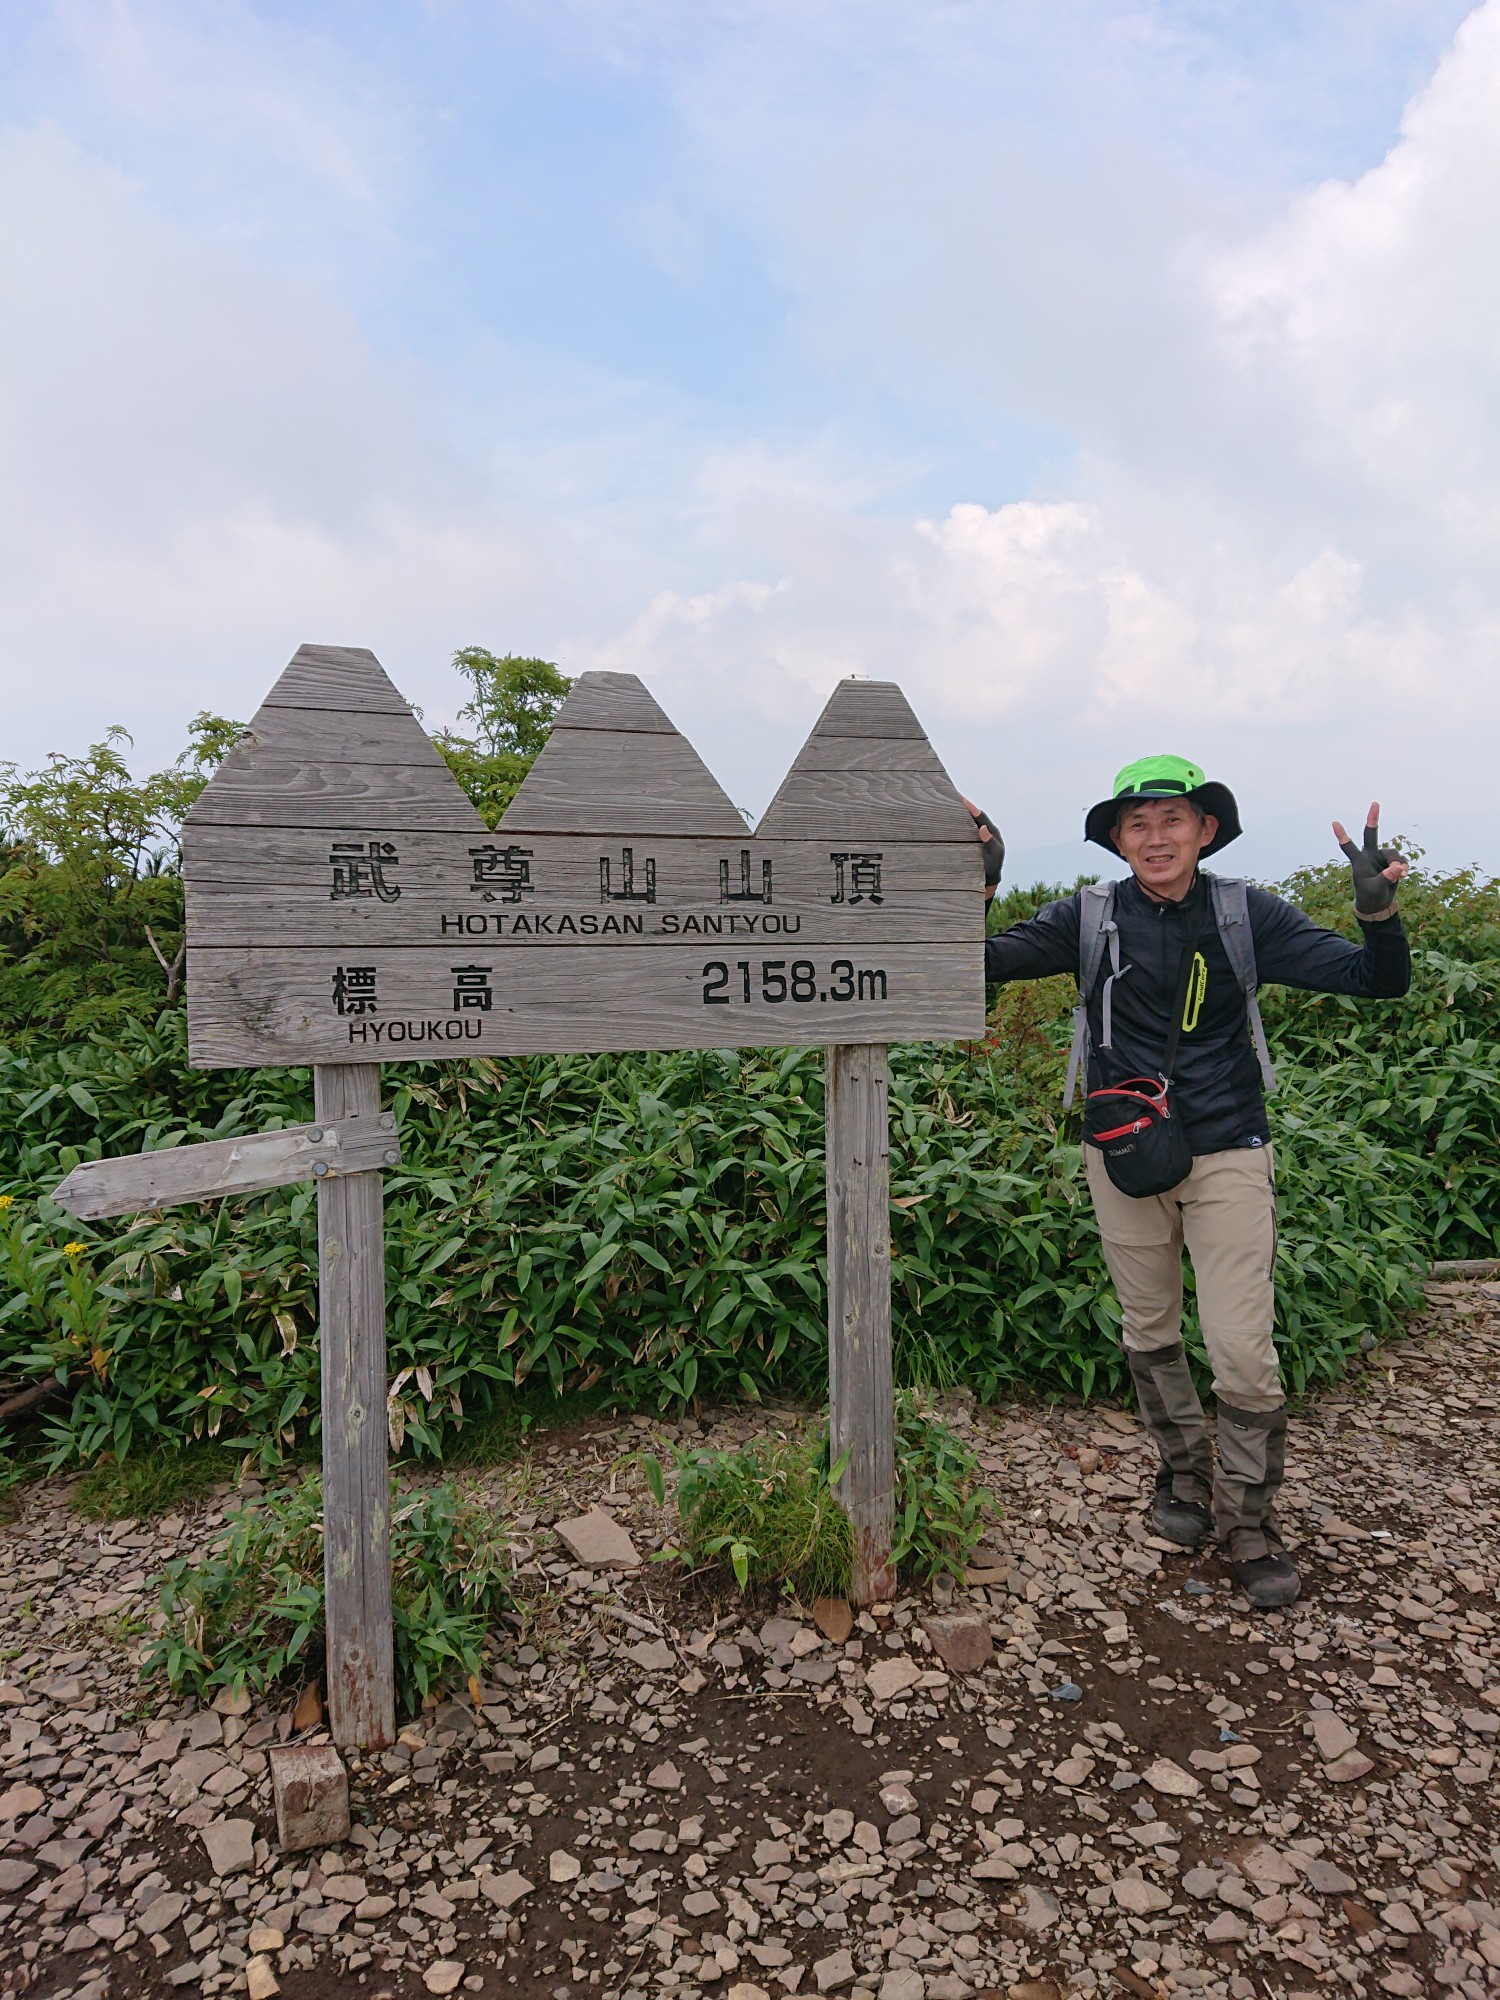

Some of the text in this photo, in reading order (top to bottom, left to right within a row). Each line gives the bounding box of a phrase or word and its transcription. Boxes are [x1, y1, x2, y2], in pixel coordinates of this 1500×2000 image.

[329, 841, 885, 905] 武尊山山頂
[441, 914, 801, 934] HOTAKASAN SANTYOU
[332, 959, 888, 1015] 標高 2158.3m
[348, 1019, 482, 1043] HYOUKOU
